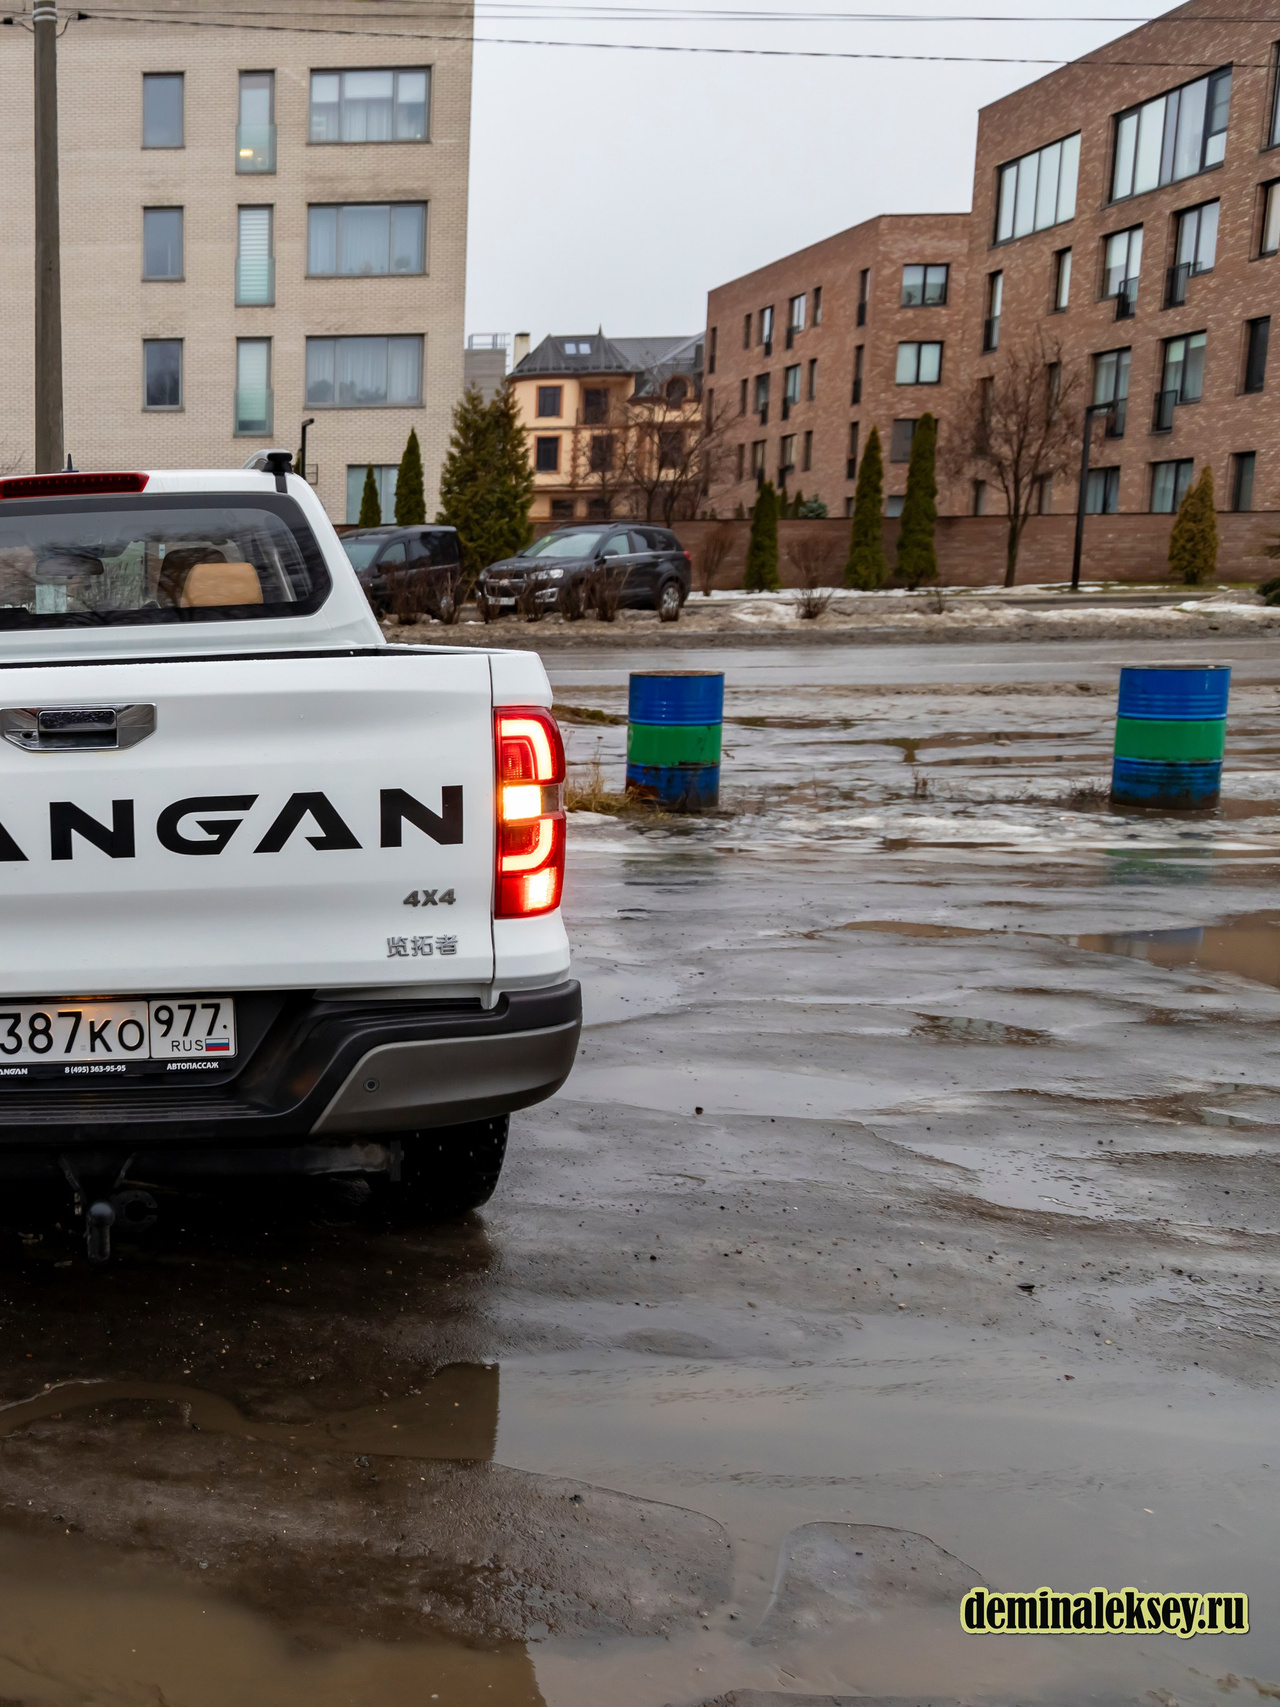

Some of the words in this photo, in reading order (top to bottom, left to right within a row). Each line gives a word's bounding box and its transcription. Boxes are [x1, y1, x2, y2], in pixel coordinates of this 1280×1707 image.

[387, 935, 458, 957] 览拓者
[154, 1003, 221, 1037] 977
[171, 1040, 204, 1052] RUS
[64, 1066, 70, 1074] 8
[70, 1065, 90, 1075] (495)
[90, 1065, 127, 1074] 363-95-95
[166, 1062, 220, 1071] АВТОПАССАЖ
